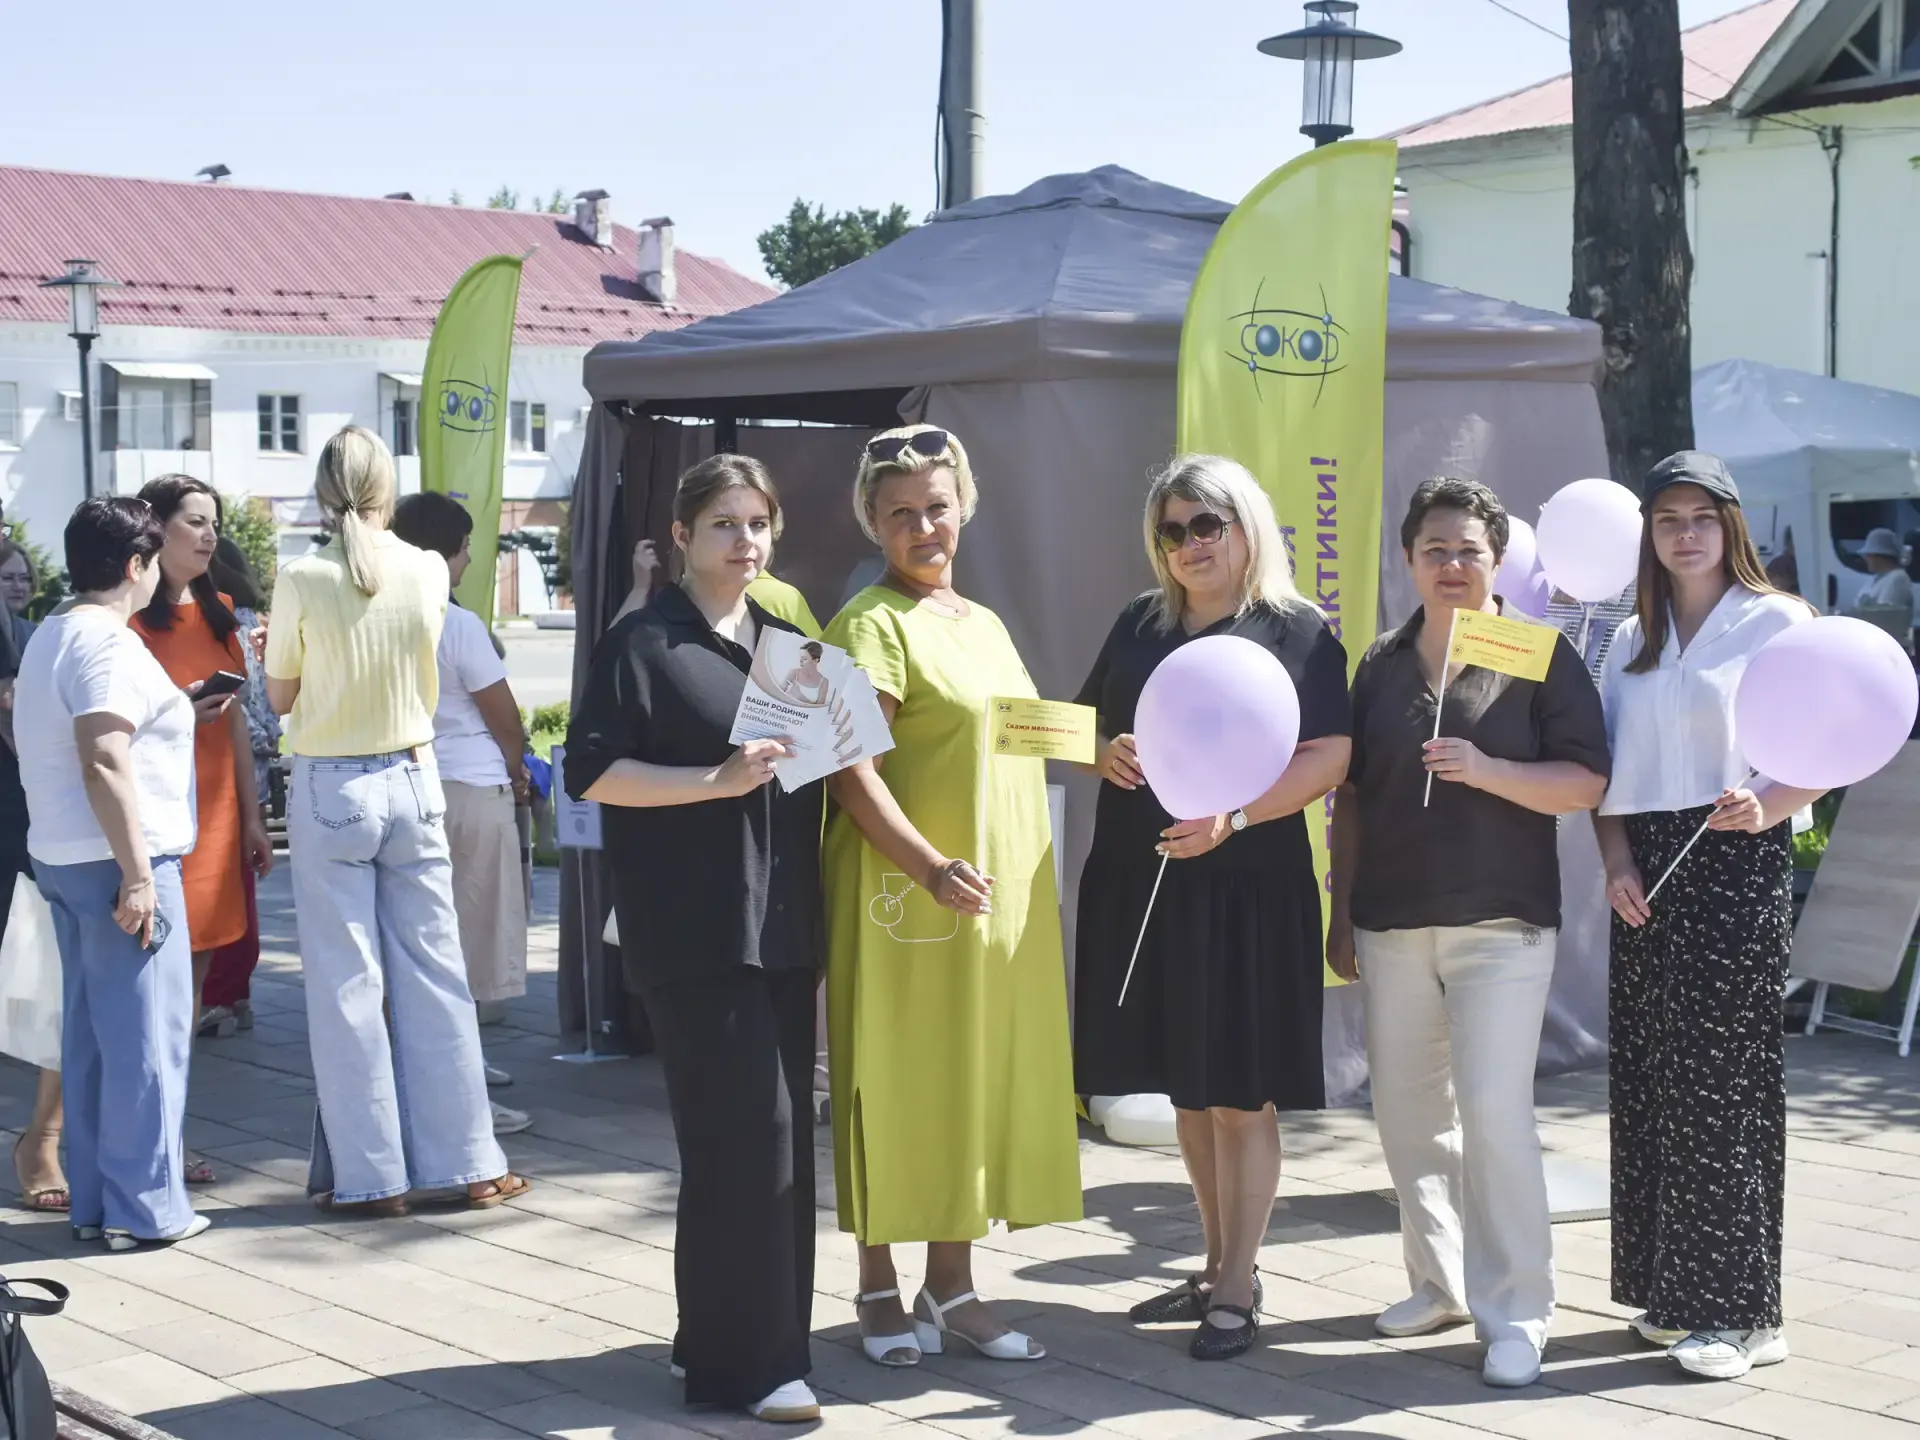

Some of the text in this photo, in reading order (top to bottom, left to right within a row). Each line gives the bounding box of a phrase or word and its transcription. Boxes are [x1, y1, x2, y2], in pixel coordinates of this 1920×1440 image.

[1462, 633, 1484, 643] Скажи
[1485, 638, 1520, 652] меланоме
[1520, 647, 1536, 656] нет!
[743, 704, 805, 727] ЗАСЛУЖИВАЮТ
[745, 695, 809, 720] ВАШИ РОДИНКИ
[740, 712, 788, 731] ВНИМАНИЯ!
[1005, 722, 1030, 731] Скажи
[1031, 725, 1066, 735] меланоме
